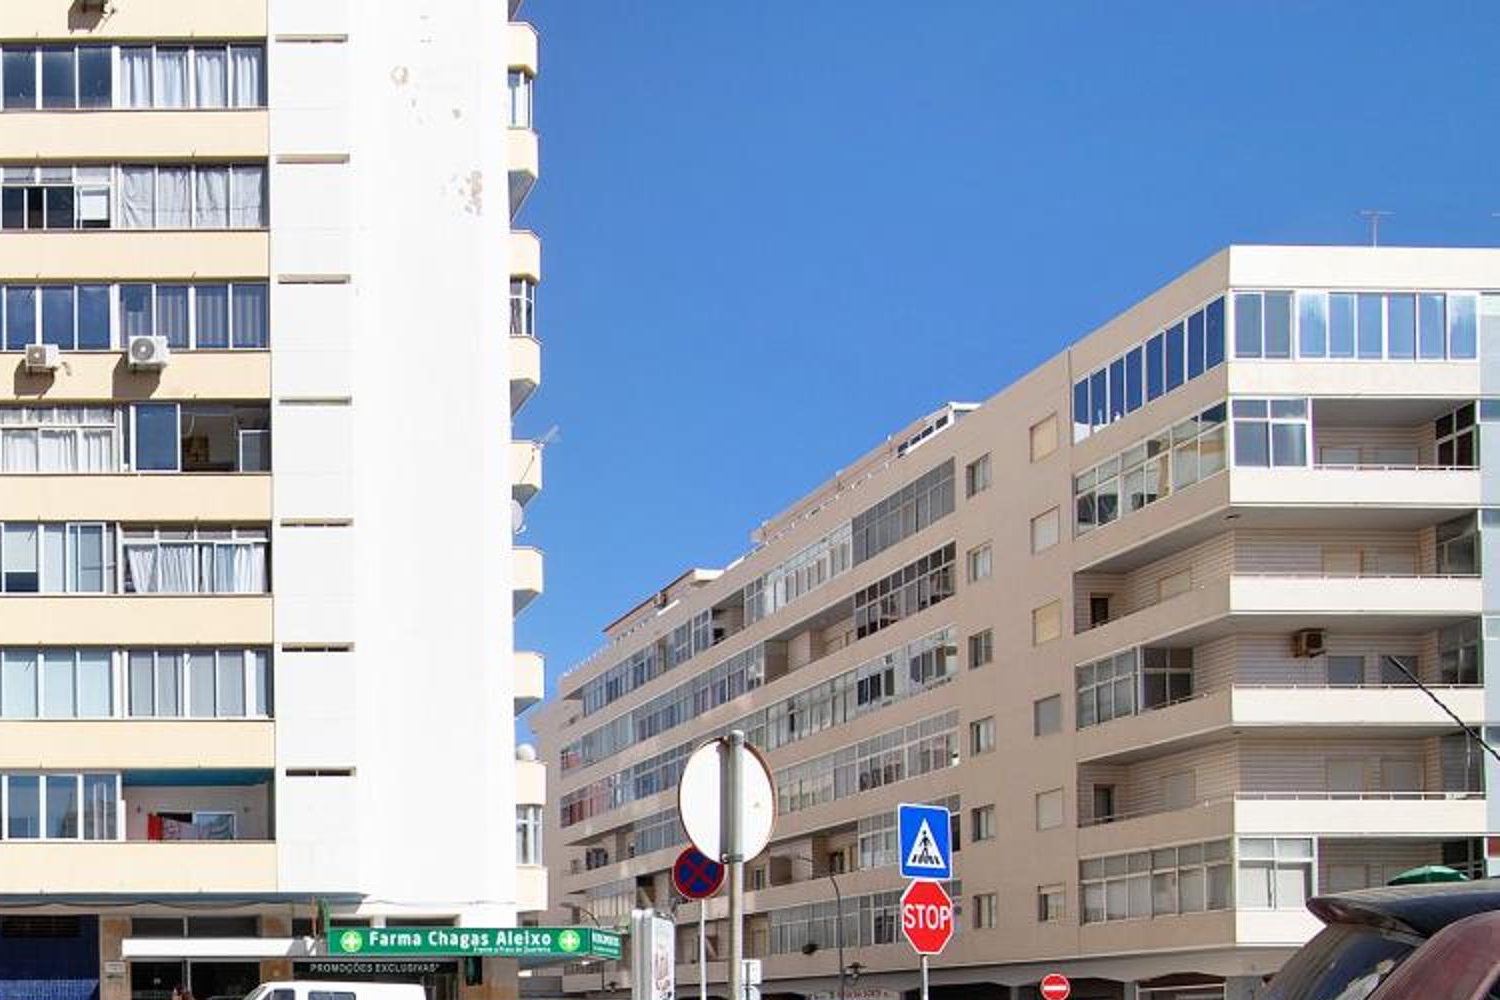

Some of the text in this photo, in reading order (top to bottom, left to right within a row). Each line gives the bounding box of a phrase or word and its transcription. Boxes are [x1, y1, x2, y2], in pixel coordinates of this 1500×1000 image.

[905, 903, 951, 930] STOP
[369, 931, 552, 949] Farma Chagas Aleixo
